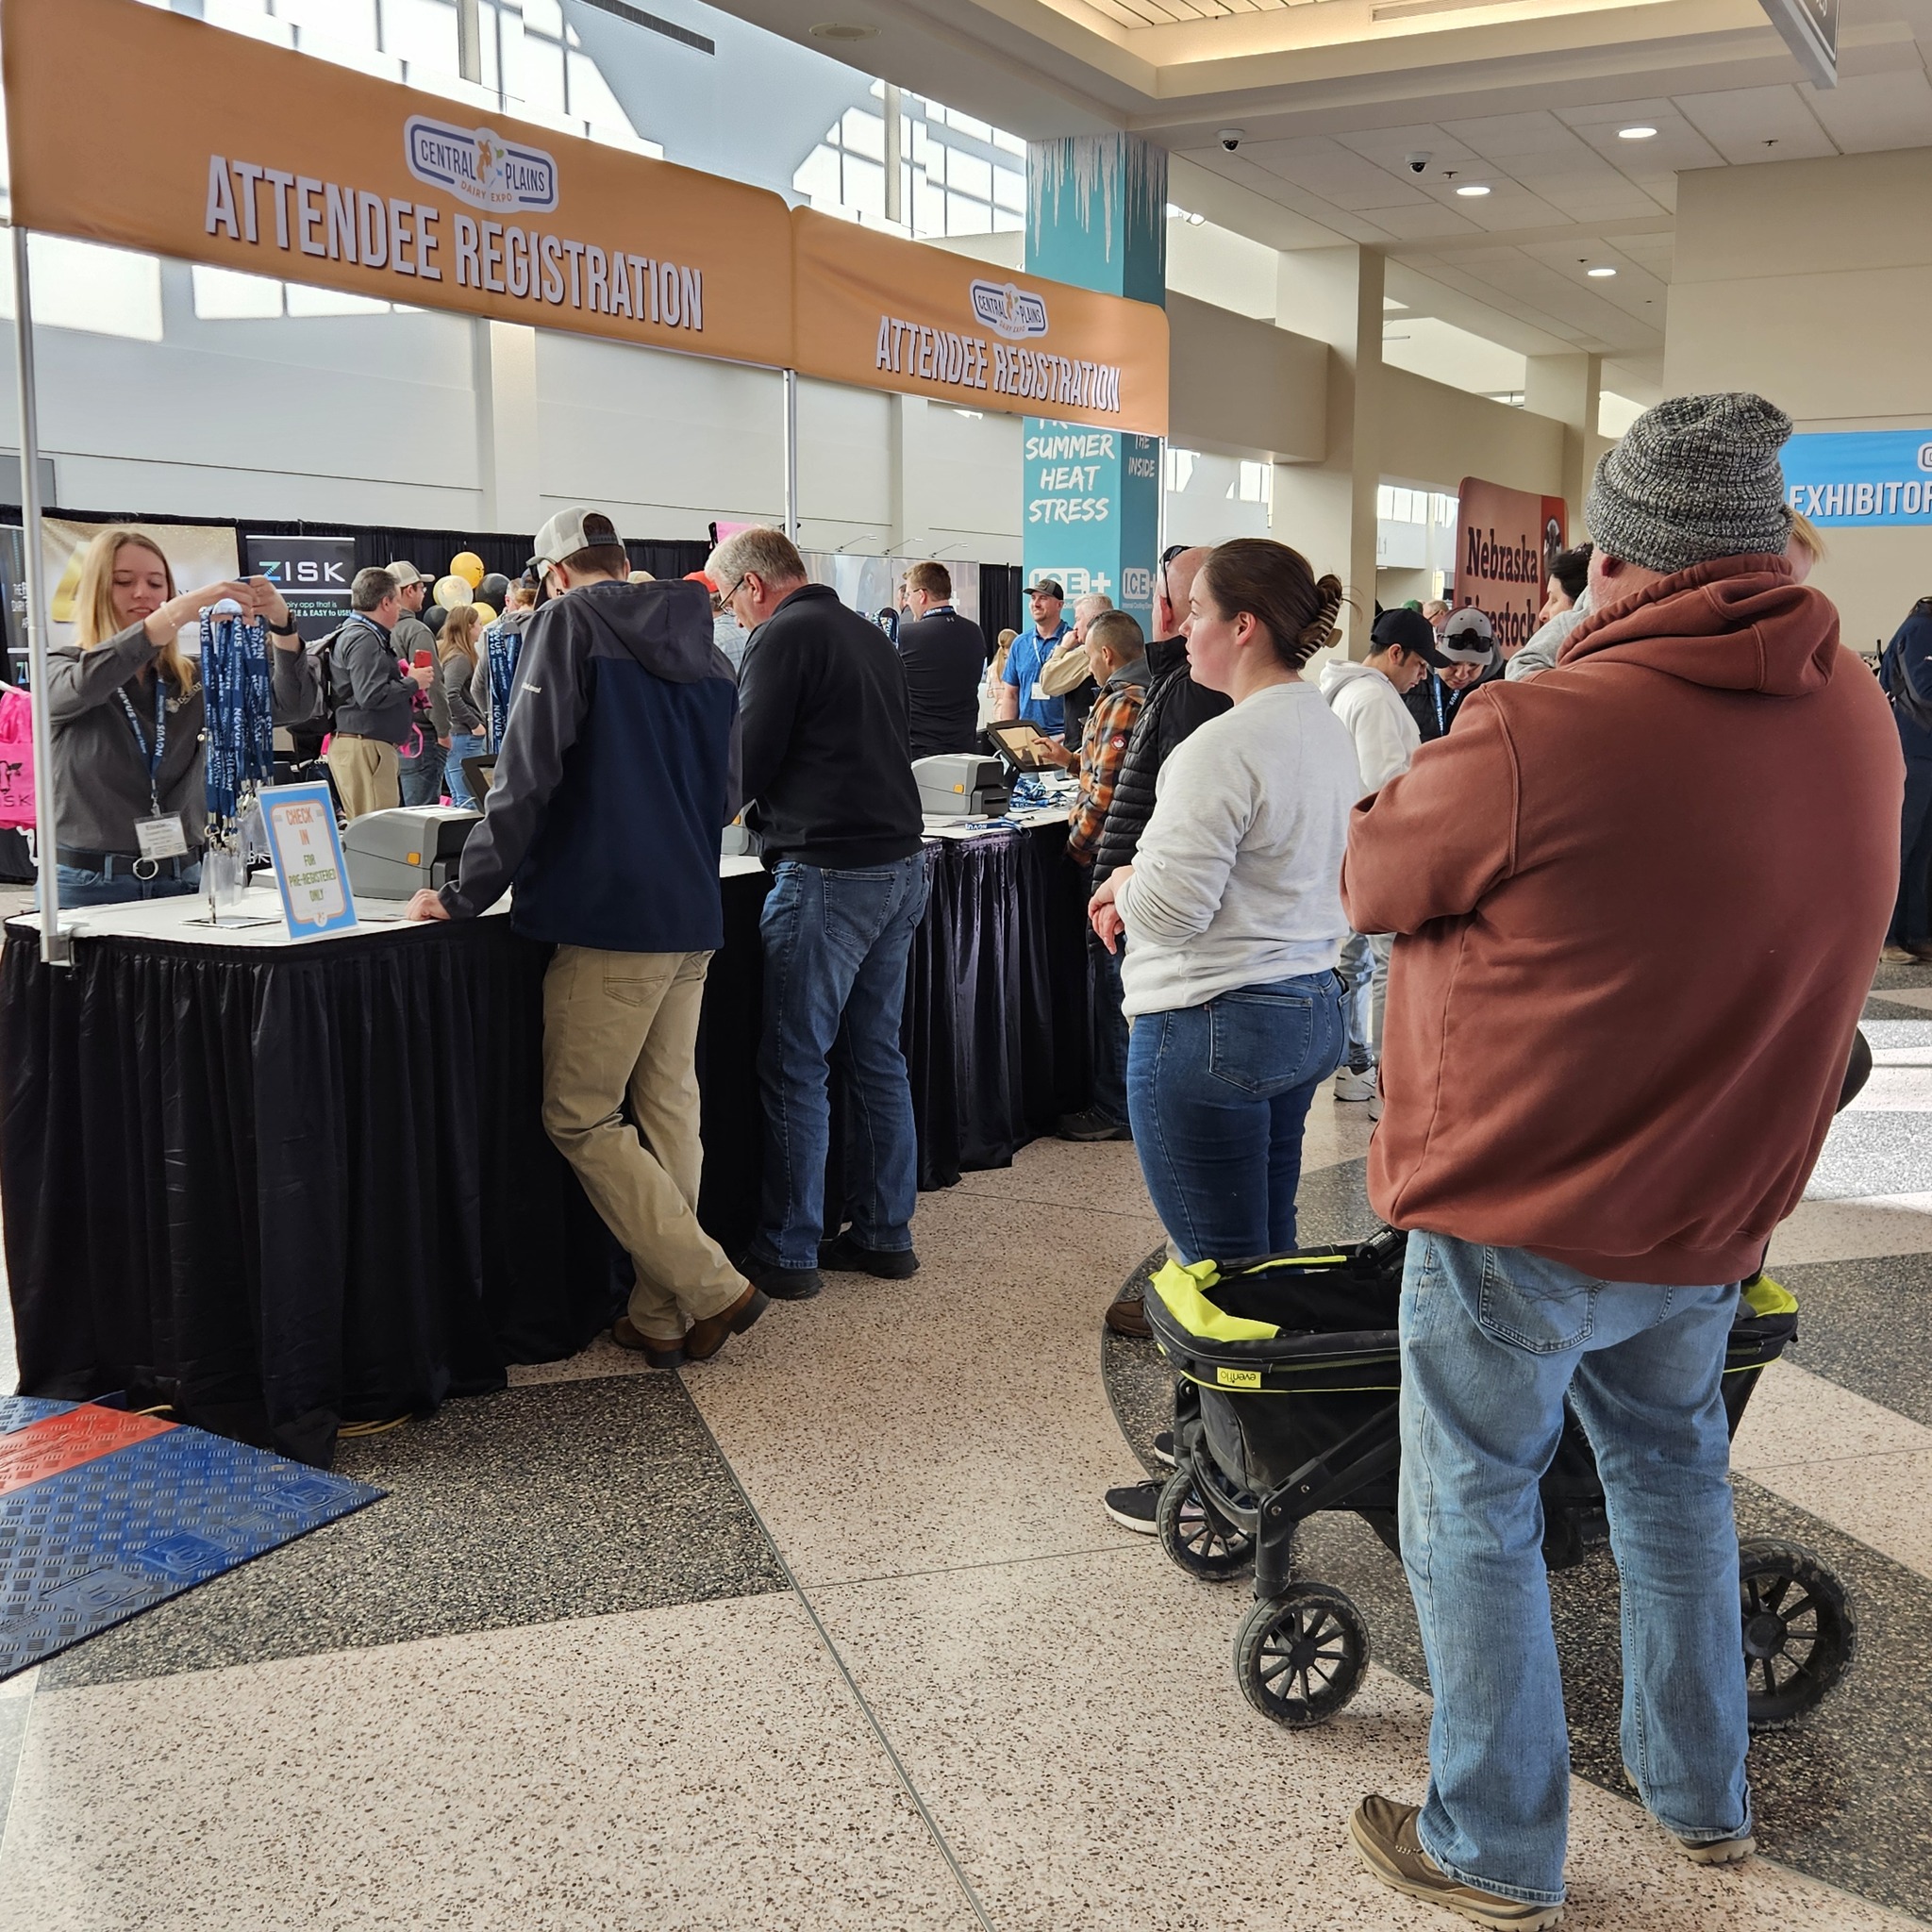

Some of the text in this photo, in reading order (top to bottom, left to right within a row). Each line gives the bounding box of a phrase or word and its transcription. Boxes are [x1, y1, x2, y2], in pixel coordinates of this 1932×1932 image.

[421, 140, 544, 192] CENTRAL PLAINS
[461, 180, 512, 202] DAIRY EXPO
[205, 155, 704, 331] ATTENDEE REGISTRATION
[978, 294, 1041, 324] CENTRAL PLAINS
[875, 315, 1122, 412] ATTENDEE REGISTRATION
[1025, 434, 1115, 461] SUMMER
[1040, 465, 1101, 492] HEAT
[1128, 457, 1156, 477] INSIDE
[1028, 497, 1109, 525] STRESS
[1466, 526, 1539, 584] Nebraska
[258, 561, 346, 582] ZISK
[310, 608, 327, 617] EASY
[1465, 595, 1537, 647] estock
[200, 611, 210, 642] OVUS
[234, 616, 242, 648] OVUS
[493, 628, 503, 655] OVUS
[117, 687, 136, 718] NOVUS
[233, 708, 242, 747] NOVUS
[493, 704, 503, 737] NOVUS
[155, 724, 166, 757] NOVUS
[286, 808, 314, 825] CHECK
[299, 829, 310, 845] IN
[303, 854, 316, 867] FOR
[289, 868, 337, 888] PRE-REGISTERED
[309, 889, 325, 902] ONLY
[1221, 1371, 1257, 1384] evenflo
